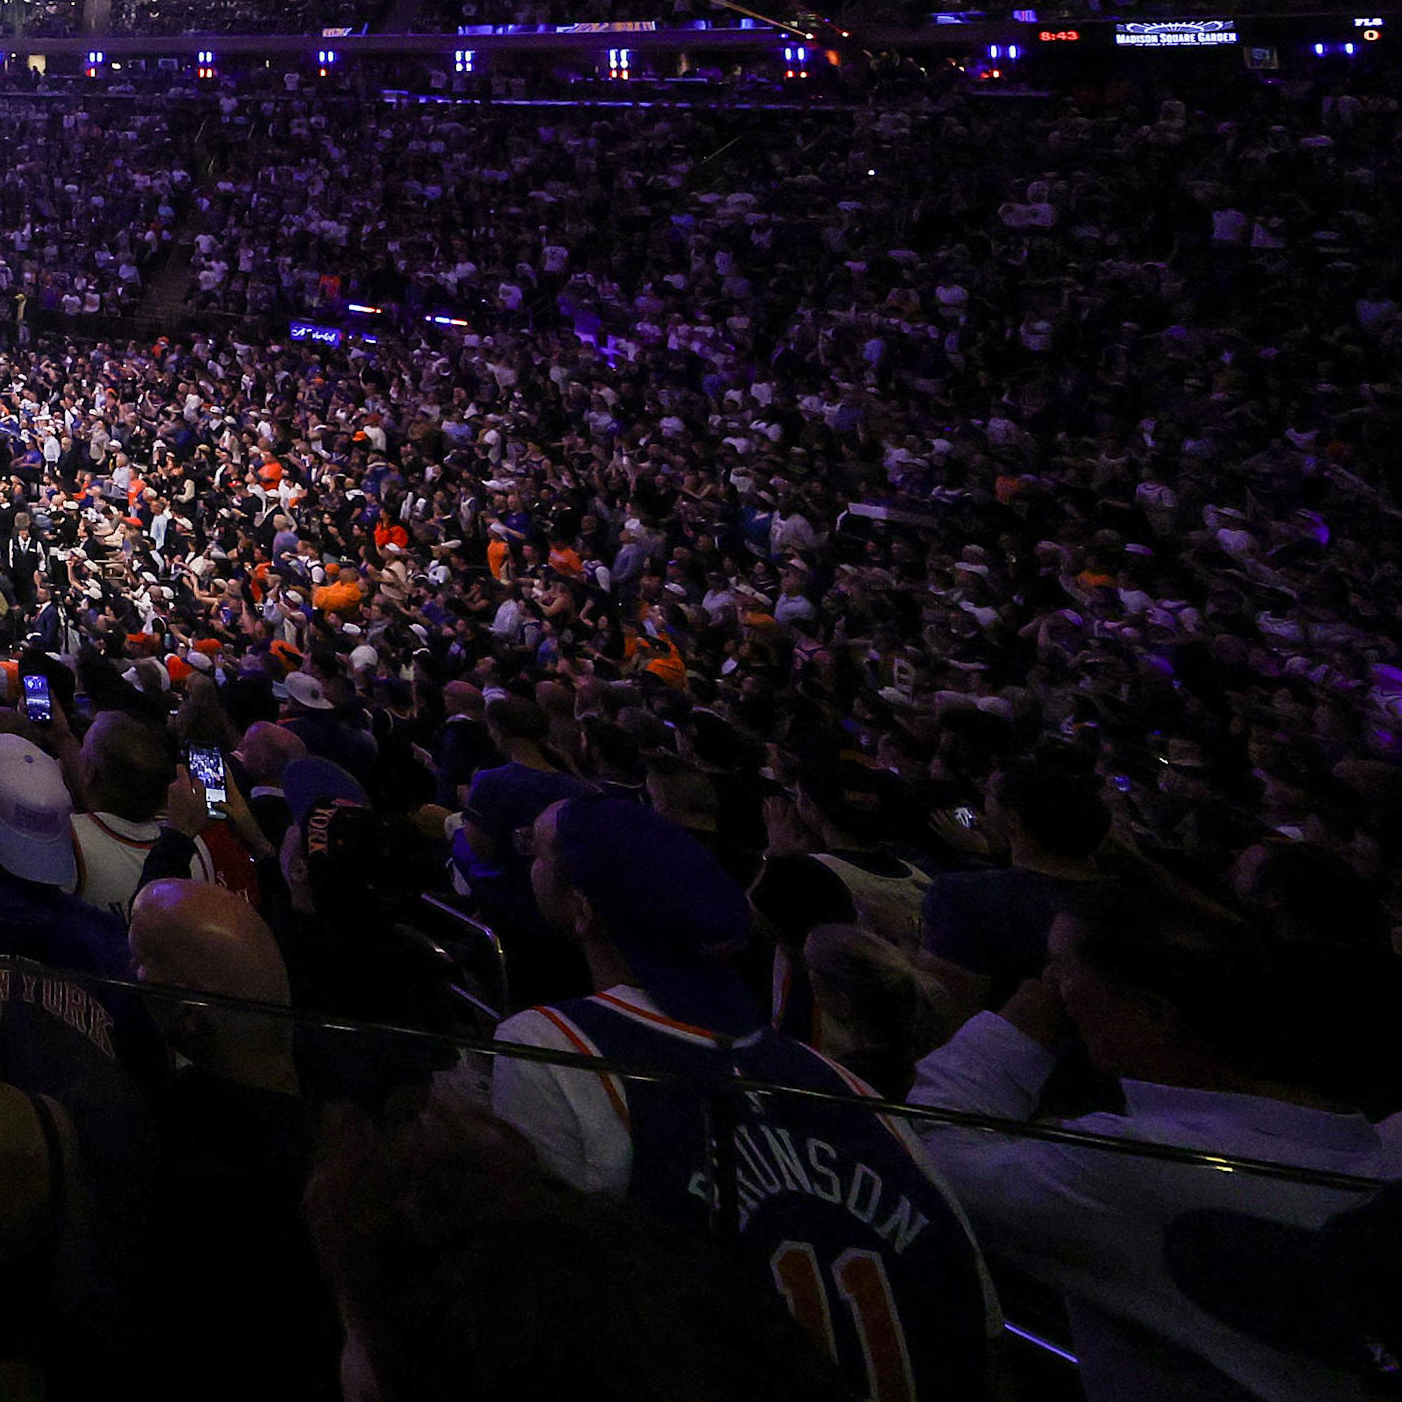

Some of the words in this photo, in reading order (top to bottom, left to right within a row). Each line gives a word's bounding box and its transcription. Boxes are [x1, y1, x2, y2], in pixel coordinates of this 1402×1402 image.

[1039, 31, 1079, 41] 8:43
[1115, 34, 1159, 45] MADISON
[1160, 33, 1196, 44] SQUARE
[1197, 32, 1237, 43] GARDEN
[1363, 29, 1379, 40] 0
[22, 972, 117, 1060] YORK
[769, 1239, 918, 1402] 11
